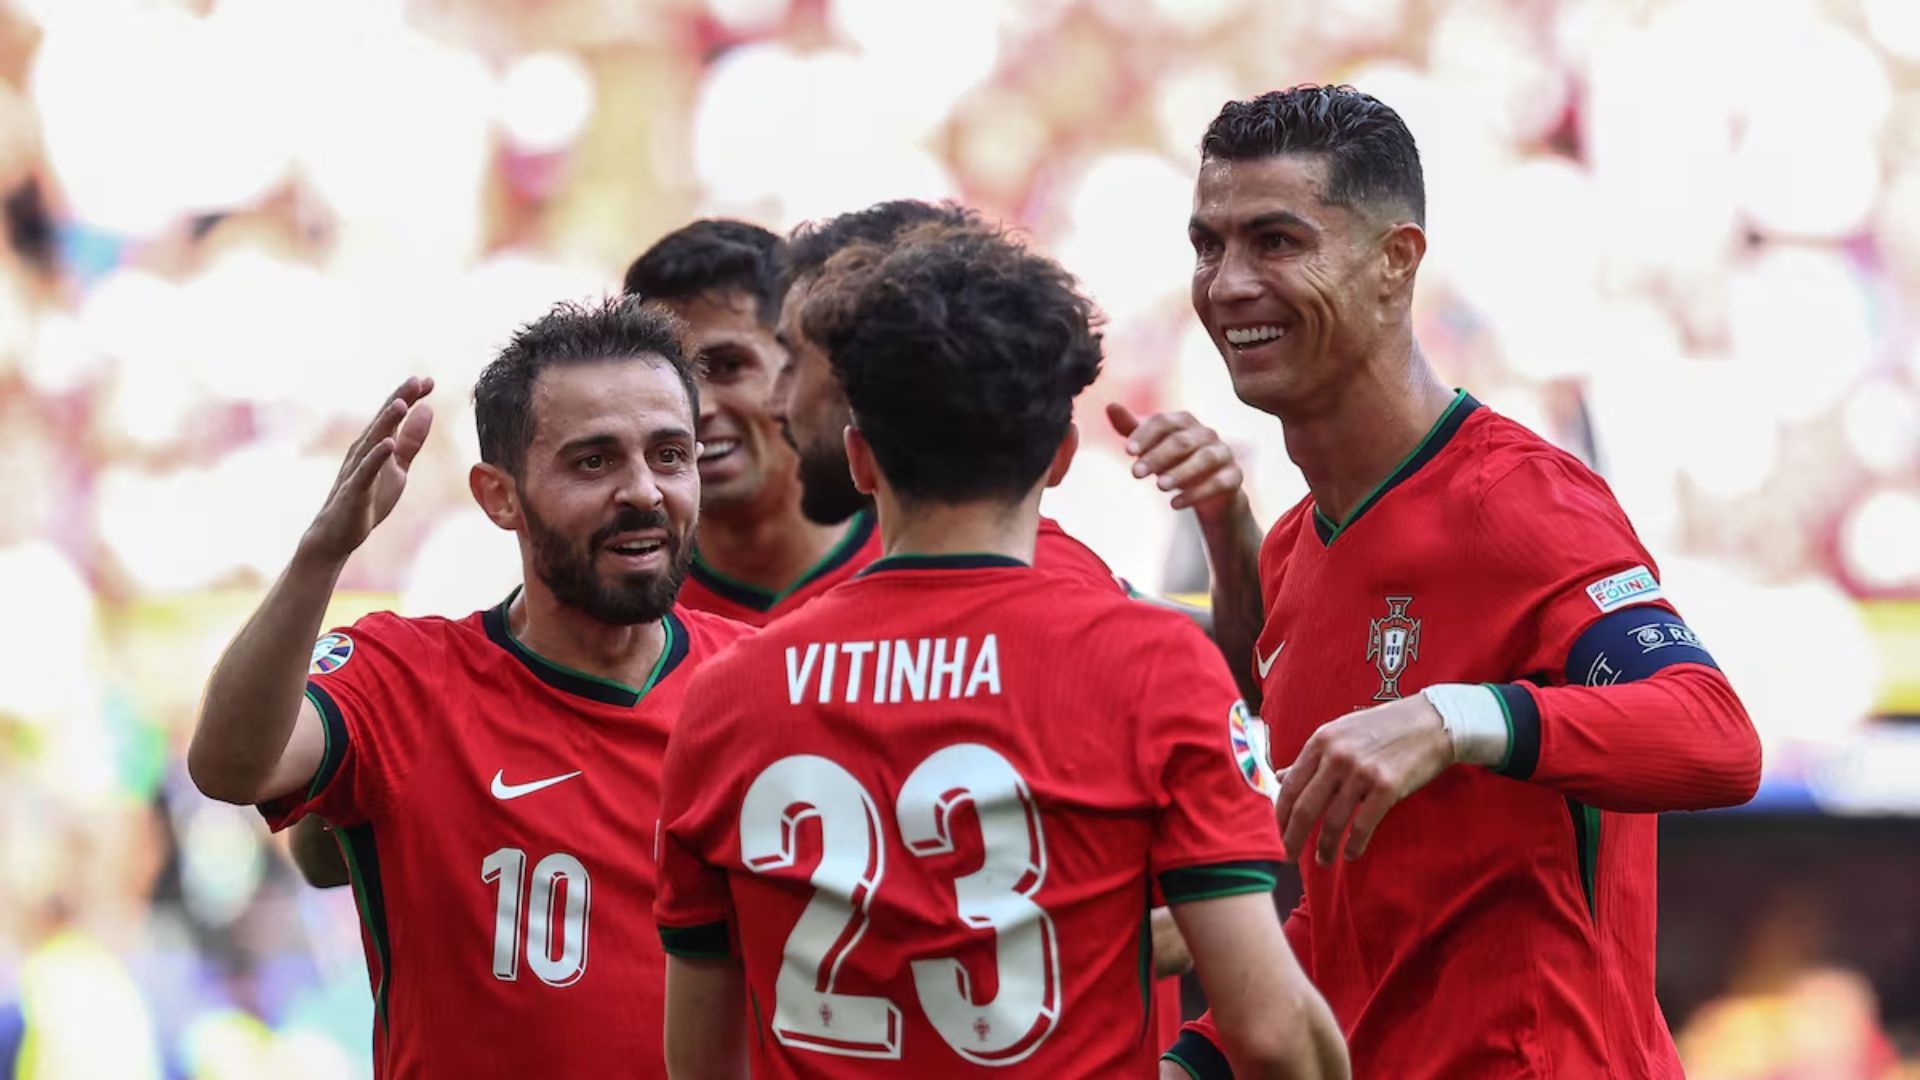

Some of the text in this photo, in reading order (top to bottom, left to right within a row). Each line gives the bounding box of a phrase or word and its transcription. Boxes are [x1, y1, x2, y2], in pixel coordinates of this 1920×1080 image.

[785, 633, 1001, 705] VITINHA
[481, 847, 591, 987] 10
[739, 742, 1062, 1067] 23
